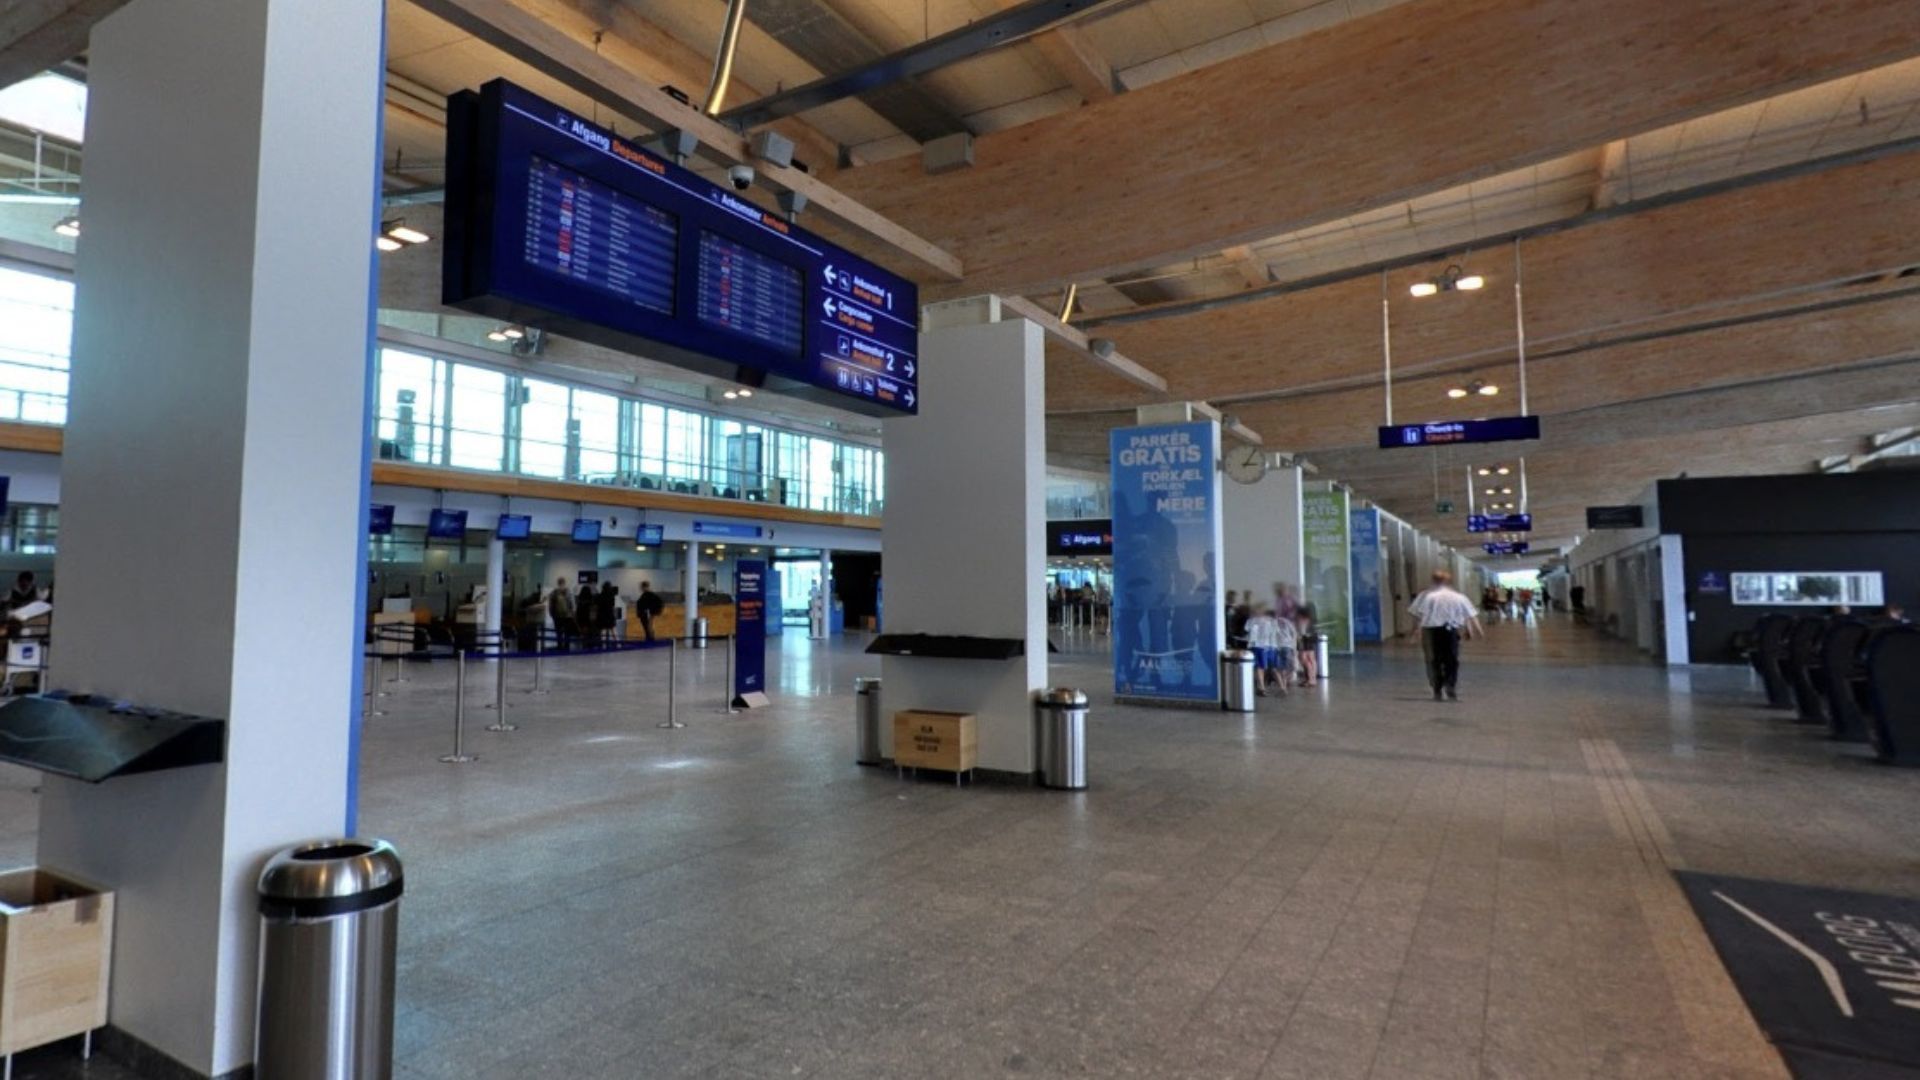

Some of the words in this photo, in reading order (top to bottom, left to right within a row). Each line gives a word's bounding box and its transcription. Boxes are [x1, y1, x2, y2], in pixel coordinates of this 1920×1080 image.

[571, 120, 610, 152] Afgang
[887, 292, 893, 310] 1
[886, 352, 895, 371] 2
[1120, 445, 1201, 466] GRATIS
[1157, 497, 1206, 512] MERE
[1073, 534, 1101, 545] Afgang
